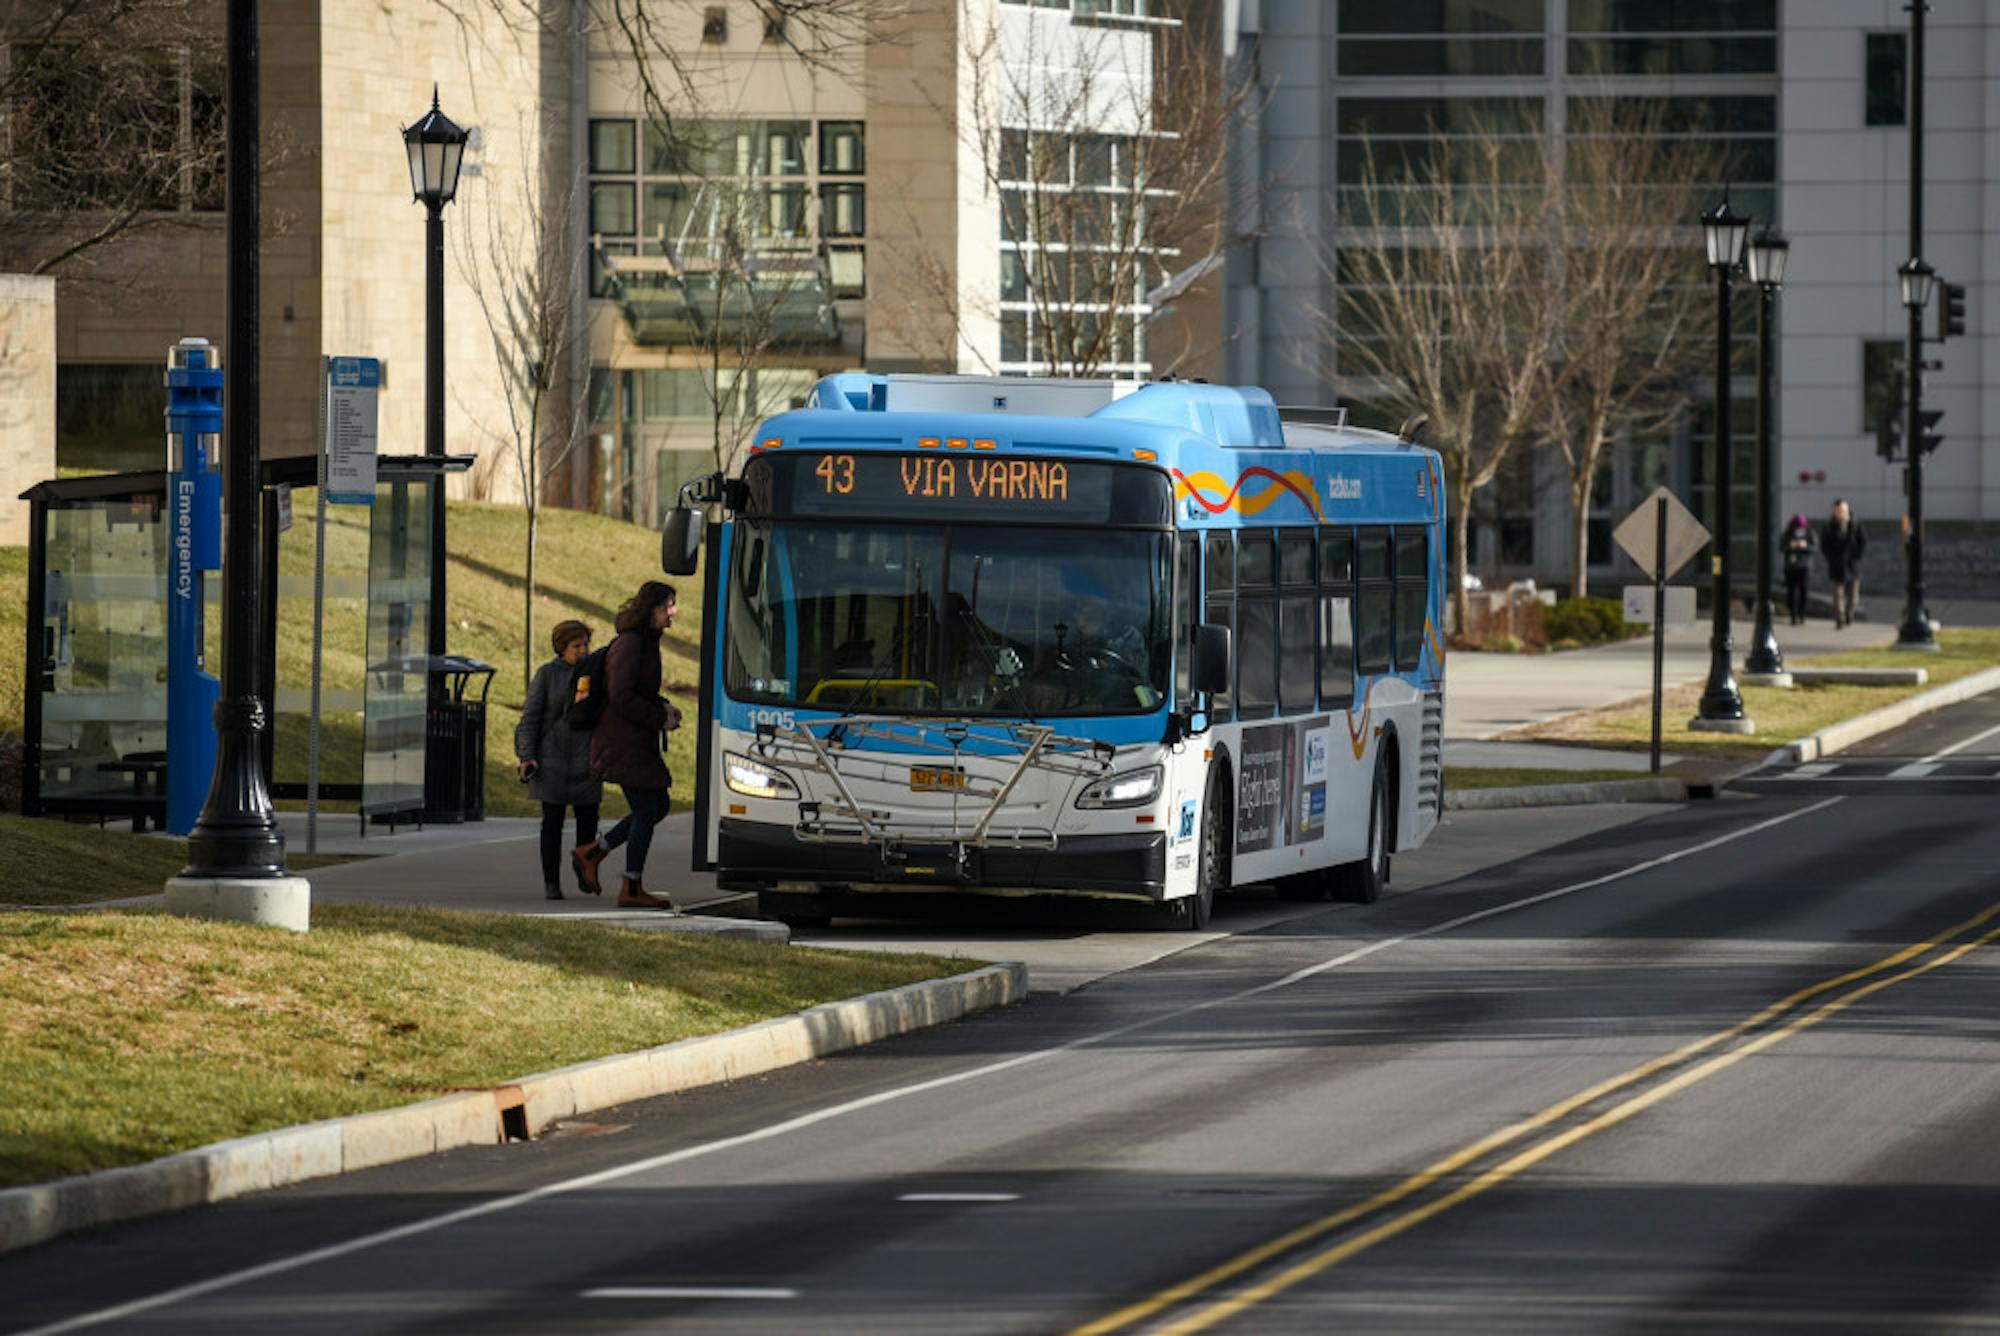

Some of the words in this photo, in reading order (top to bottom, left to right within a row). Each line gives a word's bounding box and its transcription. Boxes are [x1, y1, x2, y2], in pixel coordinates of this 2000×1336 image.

[816, 455, 855, 494] 43
[901, 457, 956, 497] VIA
[967, 459, 1069, 500] VARNA
[176, 481, 195, 600] Emergency
